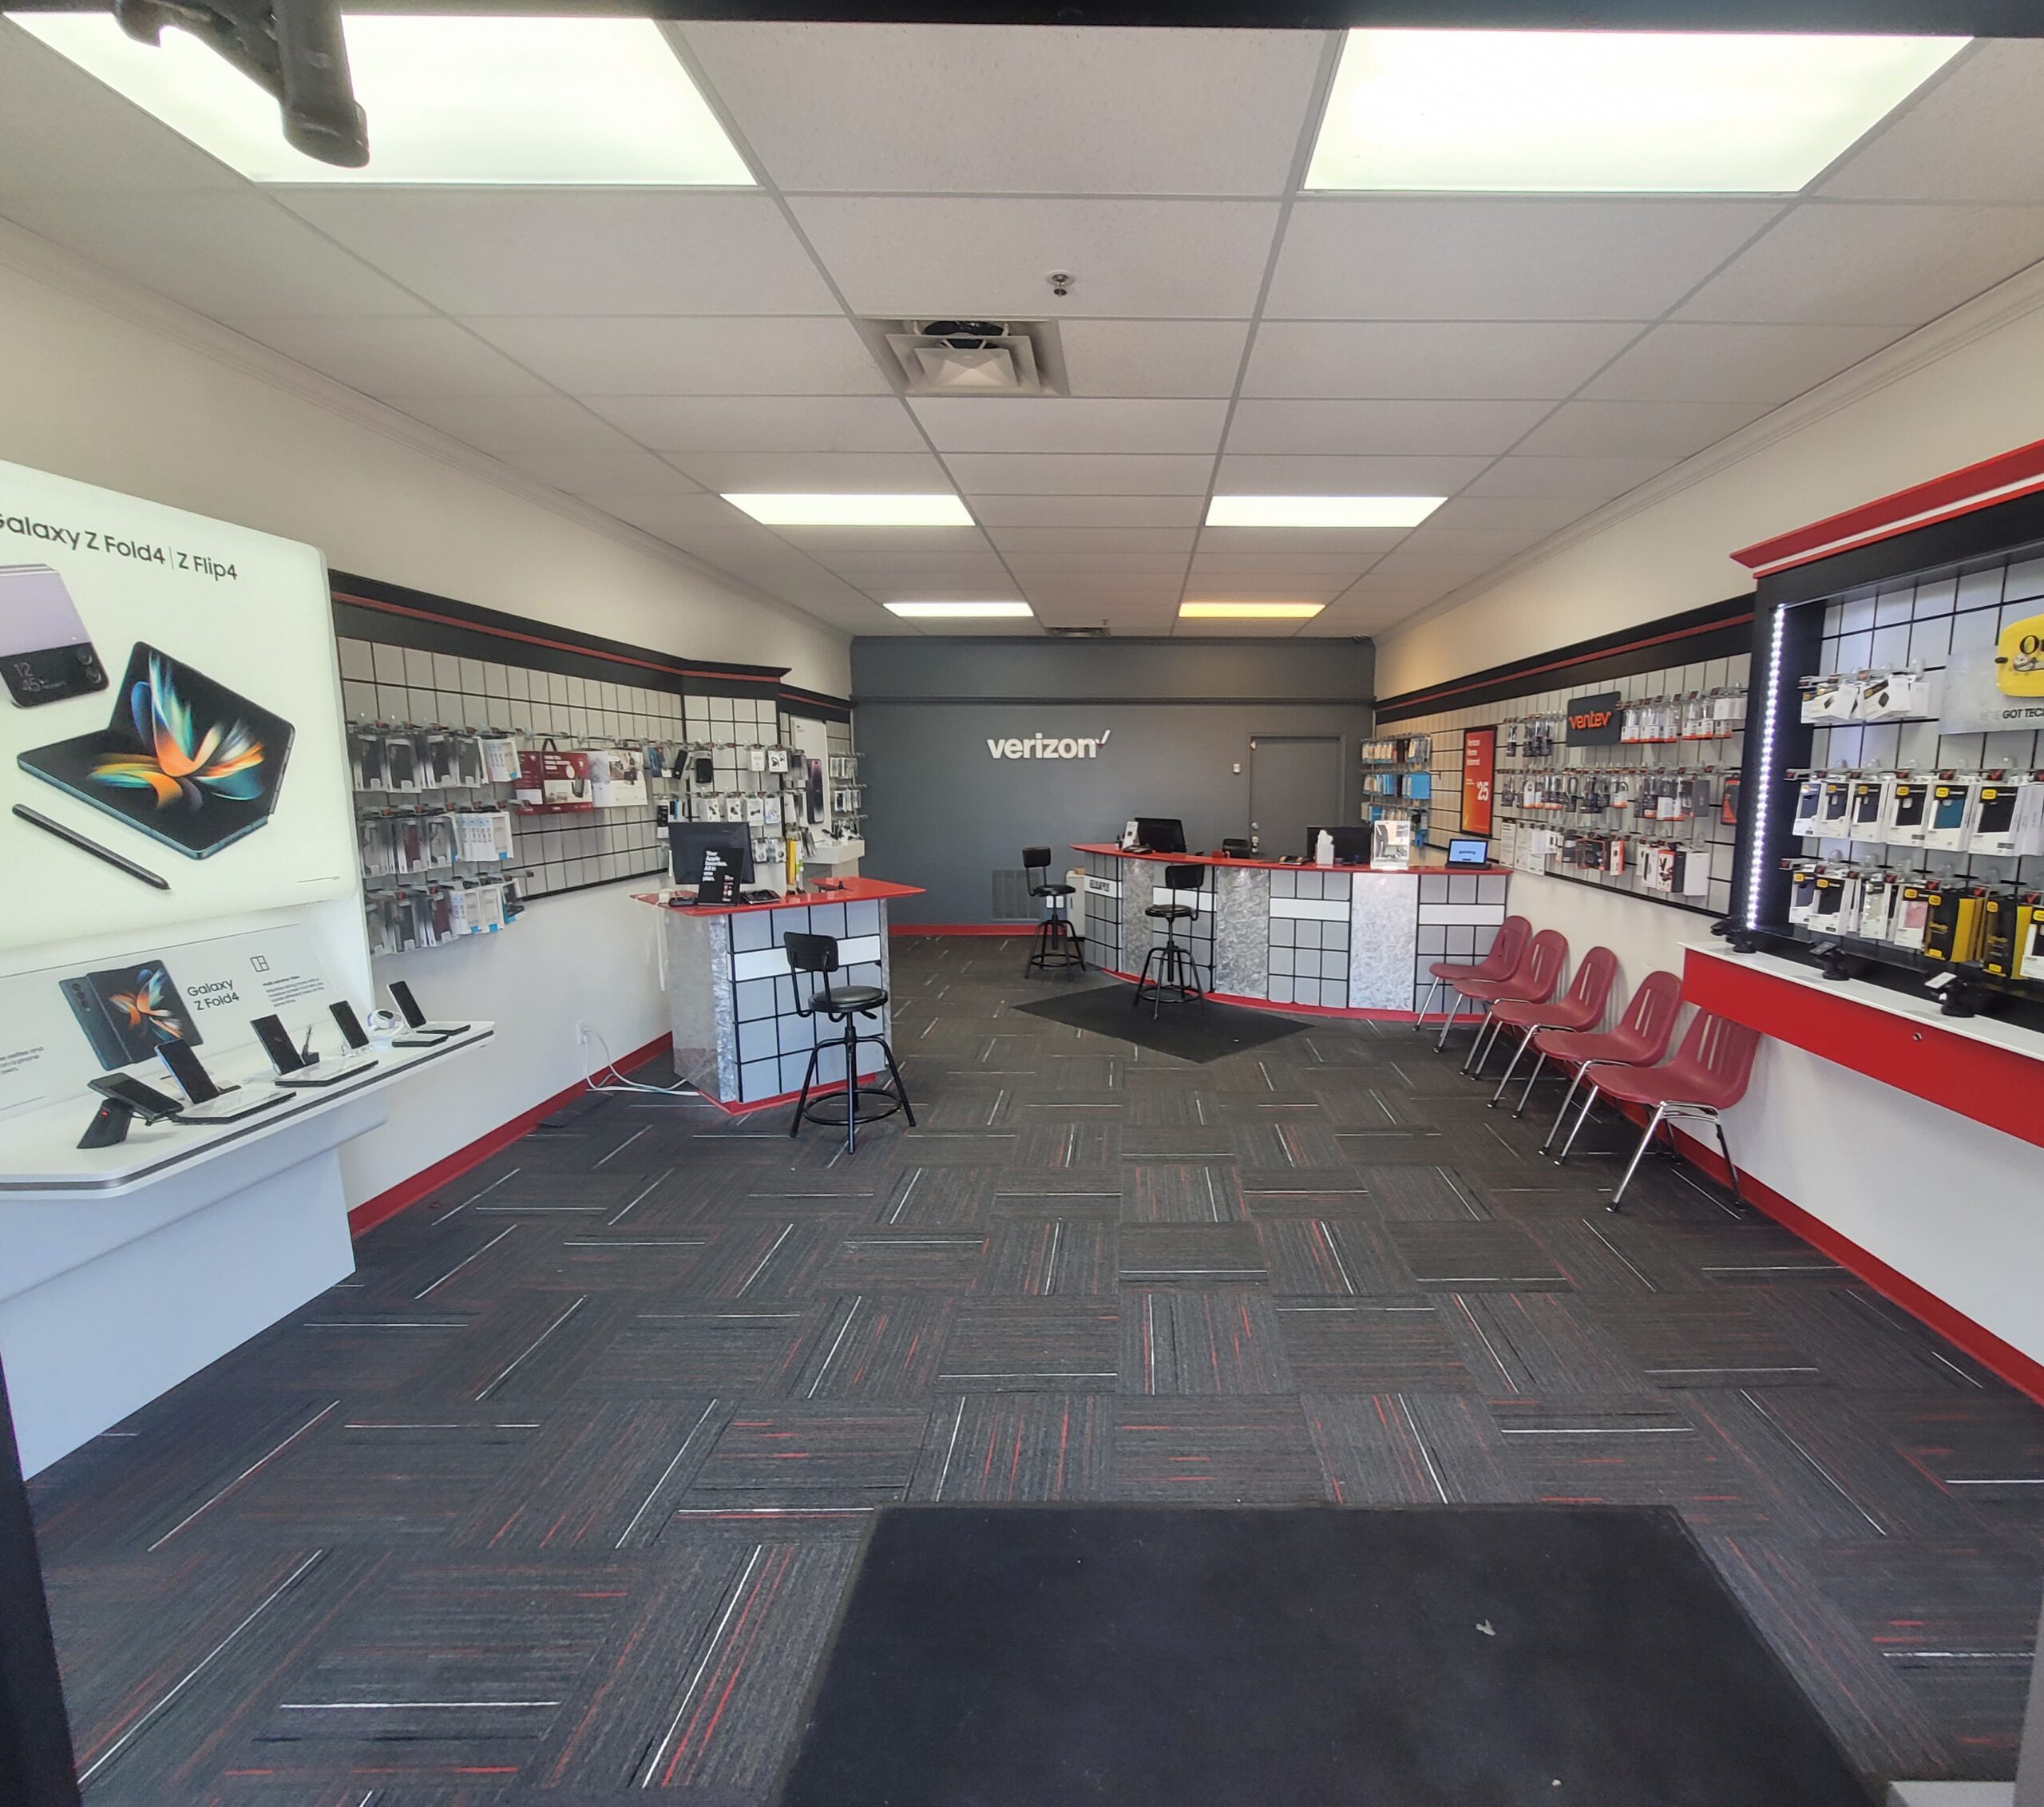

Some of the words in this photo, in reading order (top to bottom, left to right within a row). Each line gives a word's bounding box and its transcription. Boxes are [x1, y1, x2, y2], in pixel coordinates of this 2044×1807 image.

[85, 530, 100, 550] Z
[104, 535, 166, 564] Fold4
[176, 552, 189, 569] Z
[193, 555, 238, 581] Flip4
[1568, 710, 1612, 730] ventev
[2002, 709, 2022, 719] GOT
[2024, 707, 2044, 718] TEC
[987, 732, 1097, 759] verizon
[187, 979, 234, 997] Galaxy
[193, 1000, 204, 1011] Z
[204, 992, 240, 1009] Fold4
